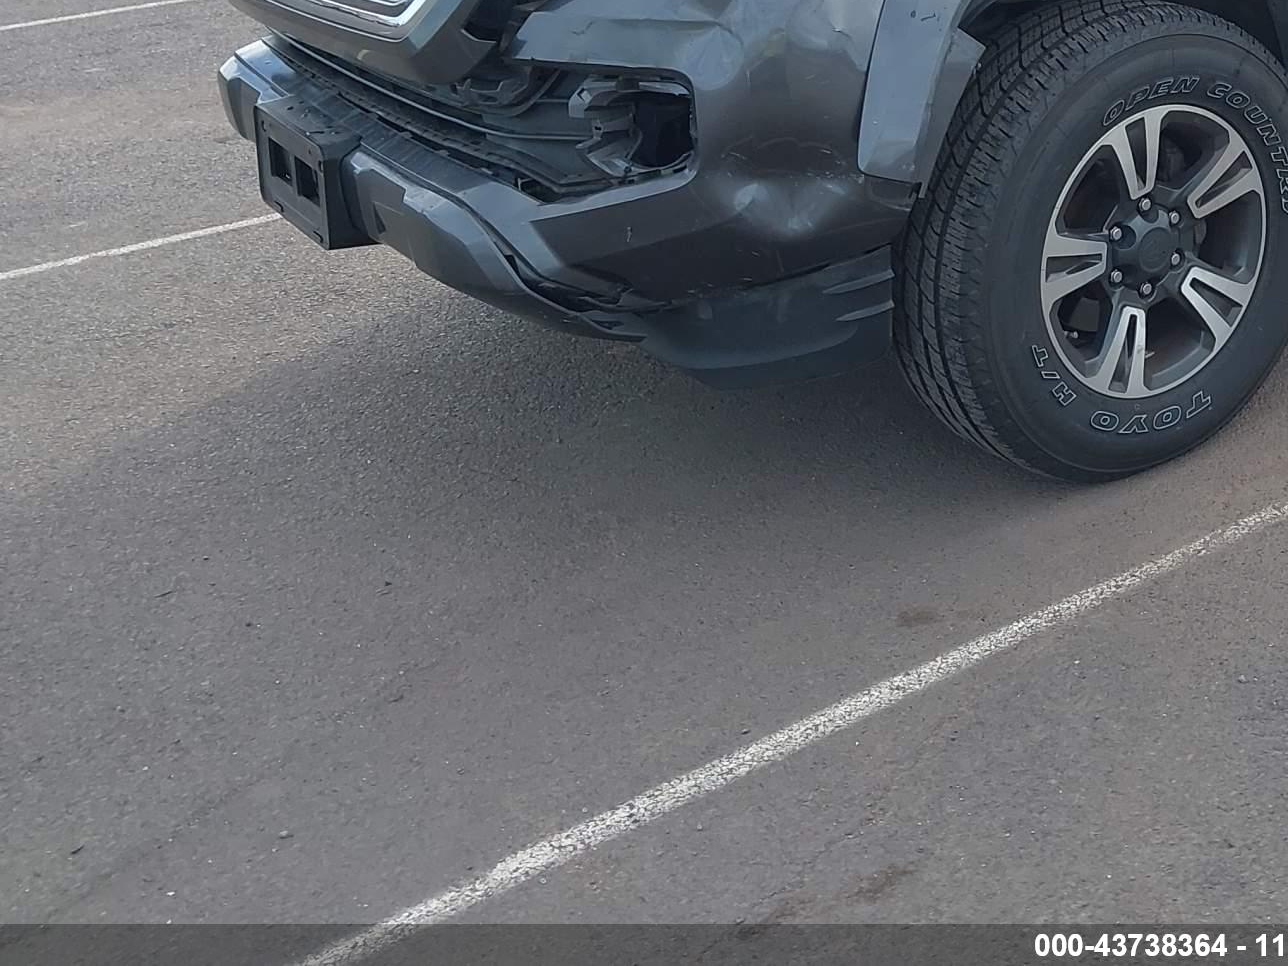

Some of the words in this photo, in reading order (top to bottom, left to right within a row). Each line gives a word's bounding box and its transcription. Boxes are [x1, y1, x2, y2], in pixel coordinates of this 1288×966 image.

[1102, 75, 1201, 127] OPEN
[1032, 344, 1077, 407] H/T
[1090, 389, 1213, 435] TOYO
